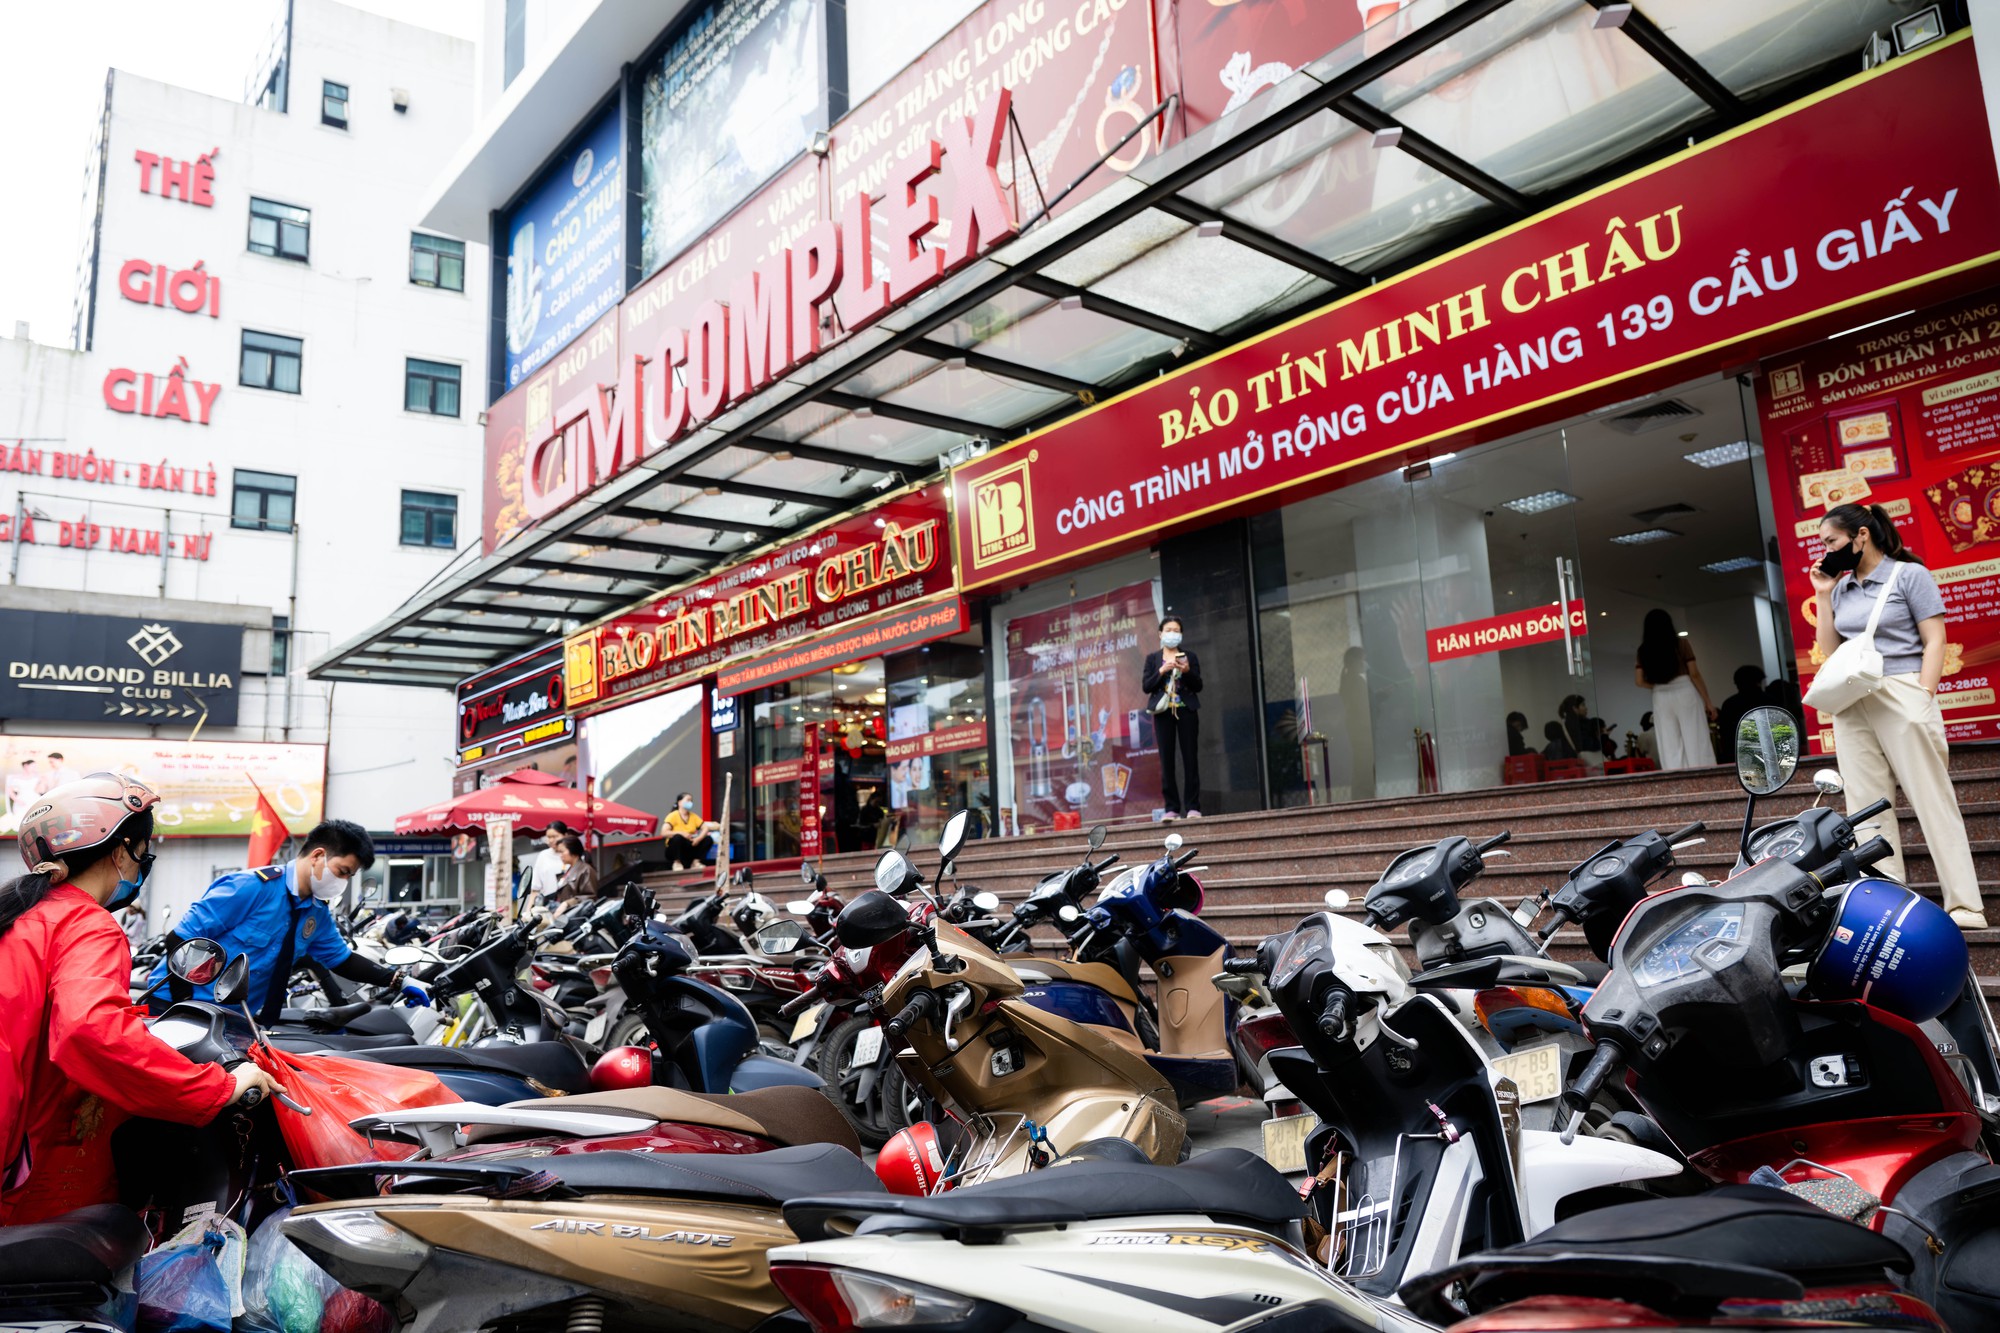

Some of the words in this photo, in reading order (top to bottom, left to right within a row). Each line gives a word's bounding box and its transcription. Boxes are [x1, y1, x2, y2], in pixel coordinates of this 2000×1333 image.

[835, 107, 893, 175] RỒNG
[894, 47, 971, 126] THĂNG
[974, 0, 1045, 69] LONG
[135, 147, 221, 208] THẾ
[768, 171, 816, 224] VÀNG
[546, 216, 581, 267] CHO
[584, 164, 621, 230] THUÊ
[119, 259, 221, 318] GIỚI
[627, 273, 675, 332] MINH
[677, 232, 733, 293] CHÂU
[646, 86, 1020, 448] COMPLEX
[1158, 386, 1239, 448] BẢO
[1247, 349, 1327, 413] TÍN
[1336, 284, 1492, 381] MINH
[1501, 204, 1684, 314] CHÂU
[1857, 331, 1910, 355] TRANG
[1913, 319, 1947, 338] SỨC
[1950, 303, 1998, 326] VÀNG
[1056, 490, 1124, 534] CÔNG
[1130, 458, 1211, 509] TRÌNH
[1218, 429, 1265, 480] MỞ
[1272, 403, 1367, 461] RỘNG
[1376, 370, 1454, 424] CỬA
[1463, 326, 1584, 395] HÀNG
[1597, 294, 1674, 348] 139
[1688, 247, 1799, 316] CẦU
[1815, 185, 1959, 272] GIẤY
[1818, 361, 1866, 389] ĐÓN
[1870, 340, 1935, 373] THẦN
[1940, 326, 1981, 352] TÀI
[1822, 390, 1846, 405] SẮM
[1848, 380, 1880, 397] VÀNG
[1916, 363, 1937, 378] TÀI
[1946, 354, 1971, 370] LỘC
[103, 356, 222, 425] GIẦY
[52, 448, 115, 484] BUÔN
[138, 458, 184, 492] BÁN
[193, 461, 217, 496] LẺ
[59, 514, 100, 550] DÉP
[110, 526, 161, 557] NAM
[1939, 569, 1966, 581] VÀNG
[601, 626, 655, 684] BẢO
[655, 606, 710, 662] TÍN
[712, 568, 813, 643] MINH
[815, 518, 938, 604] CHÂU
[684, 653, 709, 670] TRANG
[710, 646, 726, 663] SỨC
[818, 610, 835, 627] KIM
[836, 598, 870, 621] CƯƠNG
[895, 577, 924, 598] NGHỆ
[787, 651, 811, 672] VÀNG
[836, 635, 862, 657] ĐƯỢC
[861, 630, 881, 649] NHÀ
[881, 620, 909, 642] NƯỚC
[909, 615, 931, 635] CẤP
[931, 606, 957, 627] PHÉP
[1085, 625, 1109, 640] MAY
[1111, 615, 1136, 633] MẮN
[1103, 639, 1115, 654] 36
[1116, 634, 1138, 651] NĂM
[1436, 633, 1471, 653] HÂN
[1474, 623, 1523, 646] HOAN
[1525, 614, 1566, 636] ĐÓN
[9, 661, 146, 685] DIAMOND
[152, 669, 233, 690] BILLIA
[121, 686, 173, 700] CLUB
[1879, 927, 1901, 960] HOÀNG
[1887, 947, 1906, 971] HEAD
[1870, 960, 1887, 980] HỢP
[1496, 1090, 1517, 1100] HONDA
[906, 1147, 917, 1162] VAC
[913, 1163, 926, 1189] HEAD
[530, 1218, 606, 1236] AIR
[611, 1224, 736, 1247] BLADE
[1167, 1234, 1269, 1253] RSX
[1252, 1293, 1283, 1305] 110
